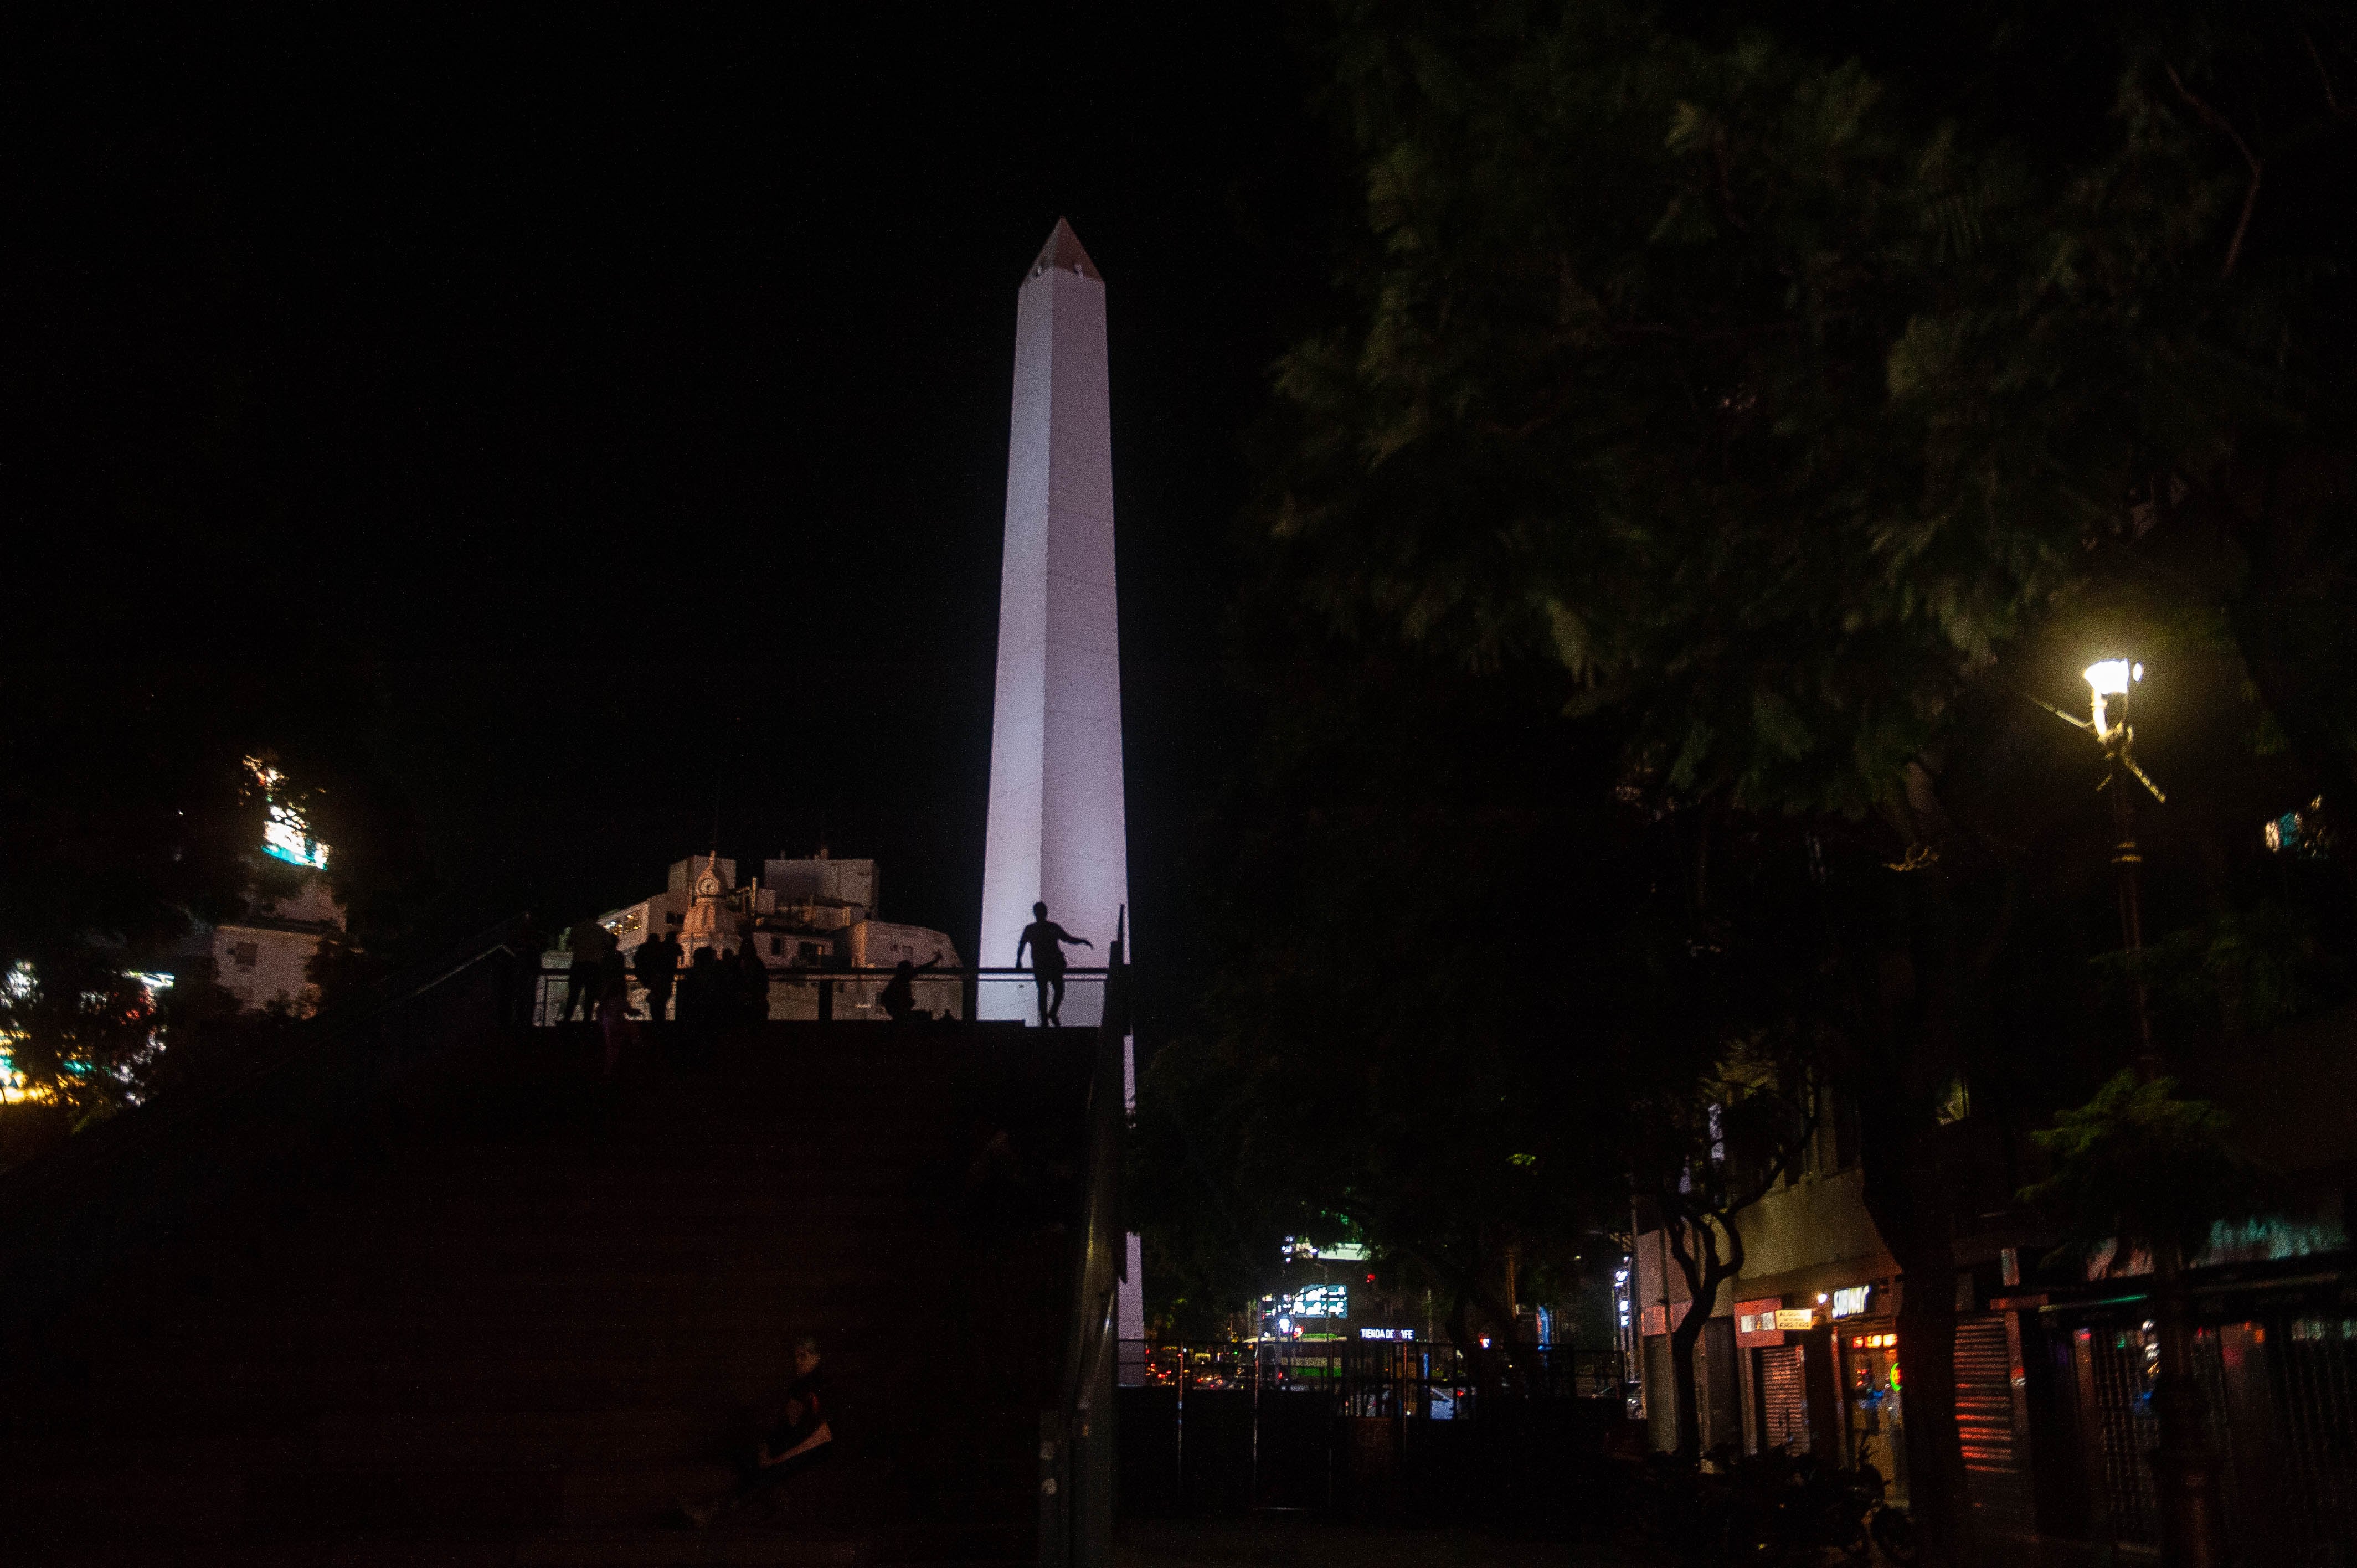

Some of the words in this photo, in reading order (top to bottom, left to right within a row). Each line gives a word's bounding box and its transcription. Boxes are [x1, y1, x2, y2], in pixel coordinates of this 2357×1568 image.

[1361, 1329, 1385, 1338] TIENDA
[1386, 1329, 1394, 1339] DE
[1397, 1329, 1413, 1339] AFE
